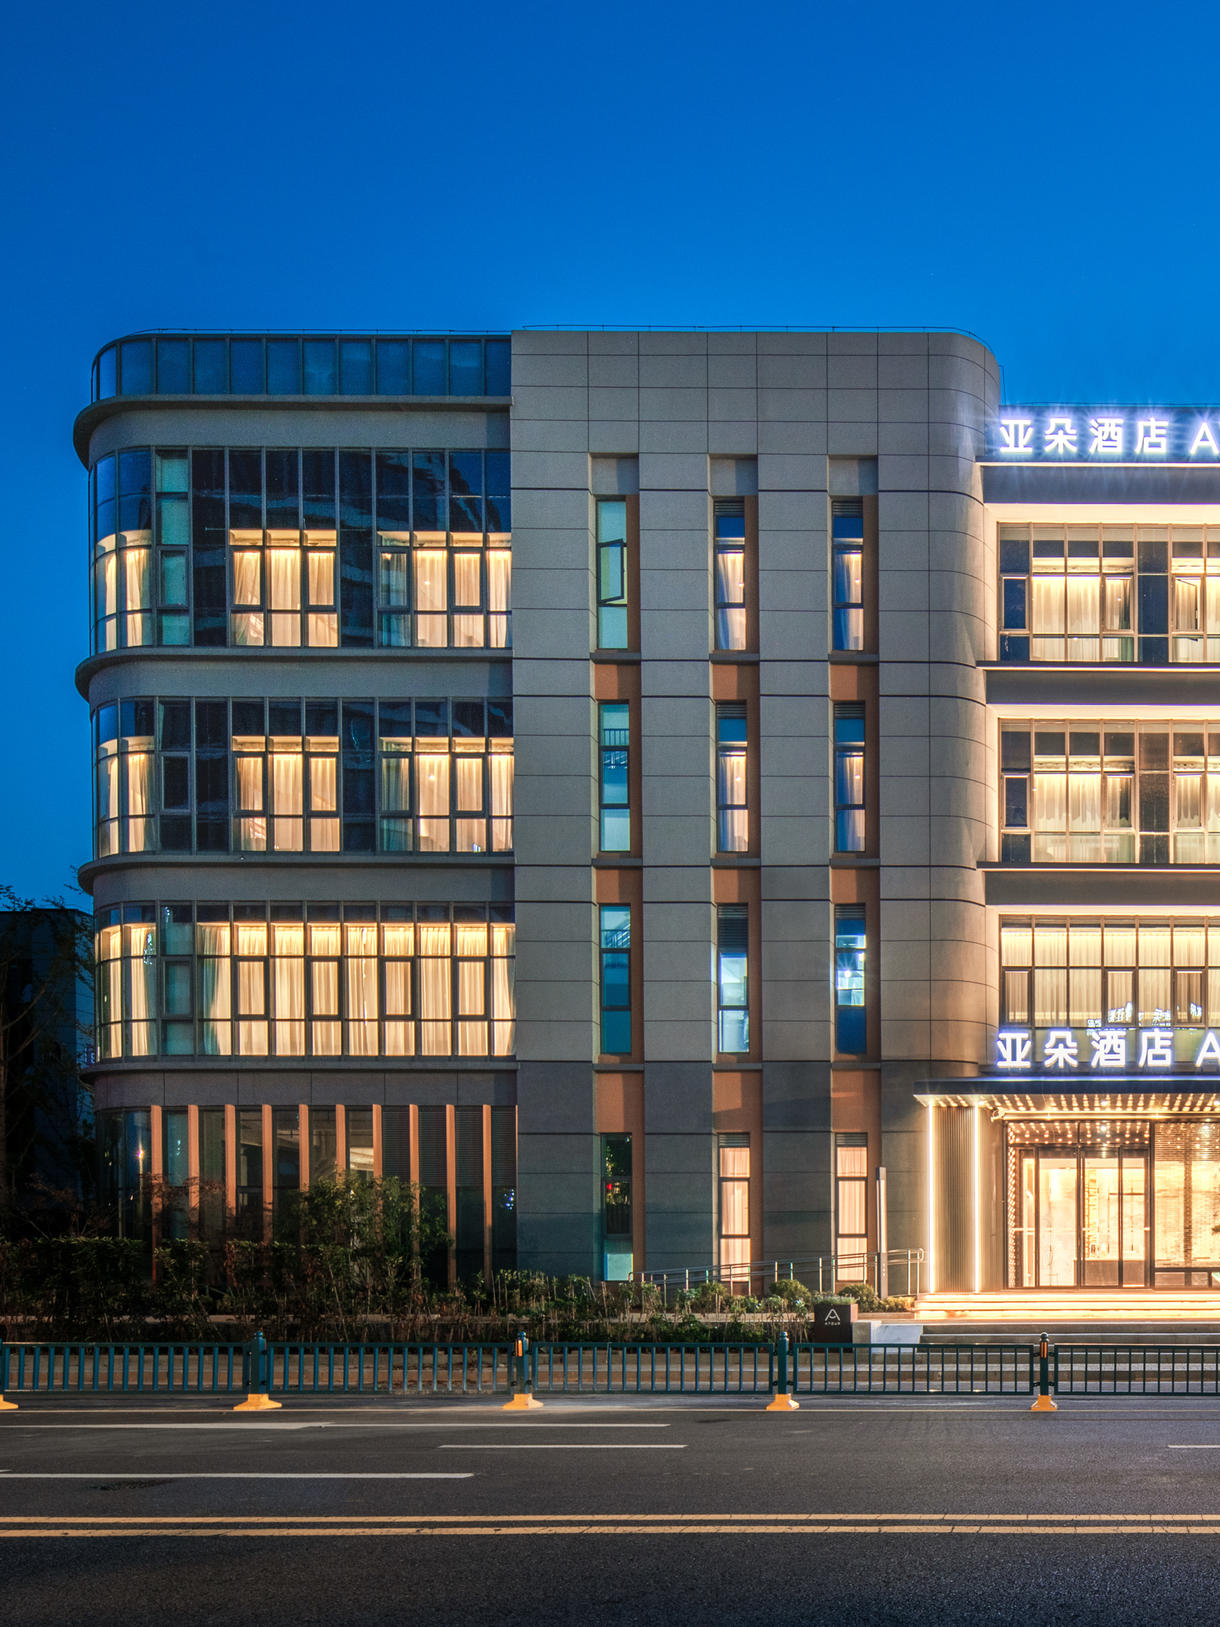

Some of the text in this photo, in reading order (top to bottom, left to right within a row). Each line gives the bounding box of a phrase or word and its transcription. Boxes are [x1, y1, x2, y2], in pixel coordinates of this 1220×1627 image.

[1000, 418, 1168, 454] 亚朵酒店
[997, 1032, 1173, 1069] 亚朵酒店
